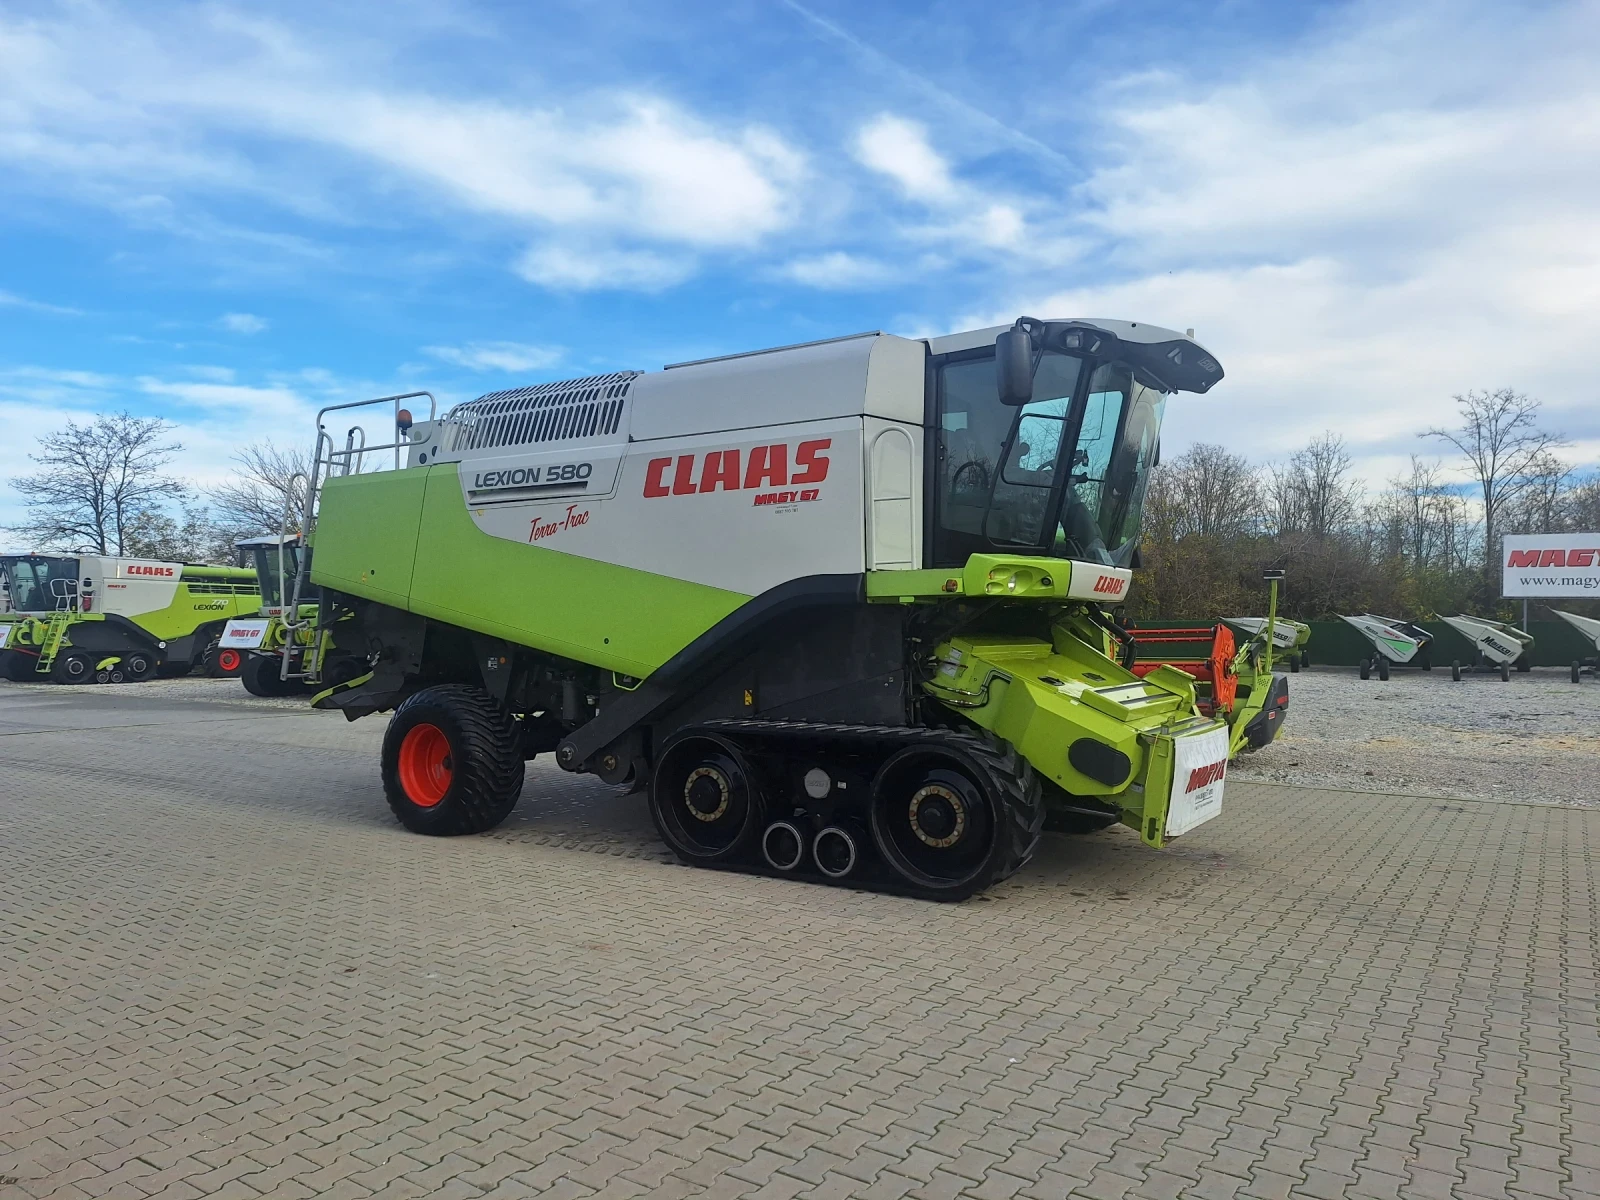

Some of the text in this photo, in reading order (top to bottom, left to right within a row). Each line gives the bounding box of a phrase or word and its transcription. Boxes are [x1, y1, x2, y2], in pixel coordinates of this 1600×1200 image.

[474, 462, 592, 488] LEXION 580
[643, 438, 832, 498] CLAAS
[754, 490, 799, 506] MAGY
[528, 504, 590, 543] Terra-Trac
[127, 565, 174, 577] CLAAS
[1093, 575, 1126, 595] CLAAS
